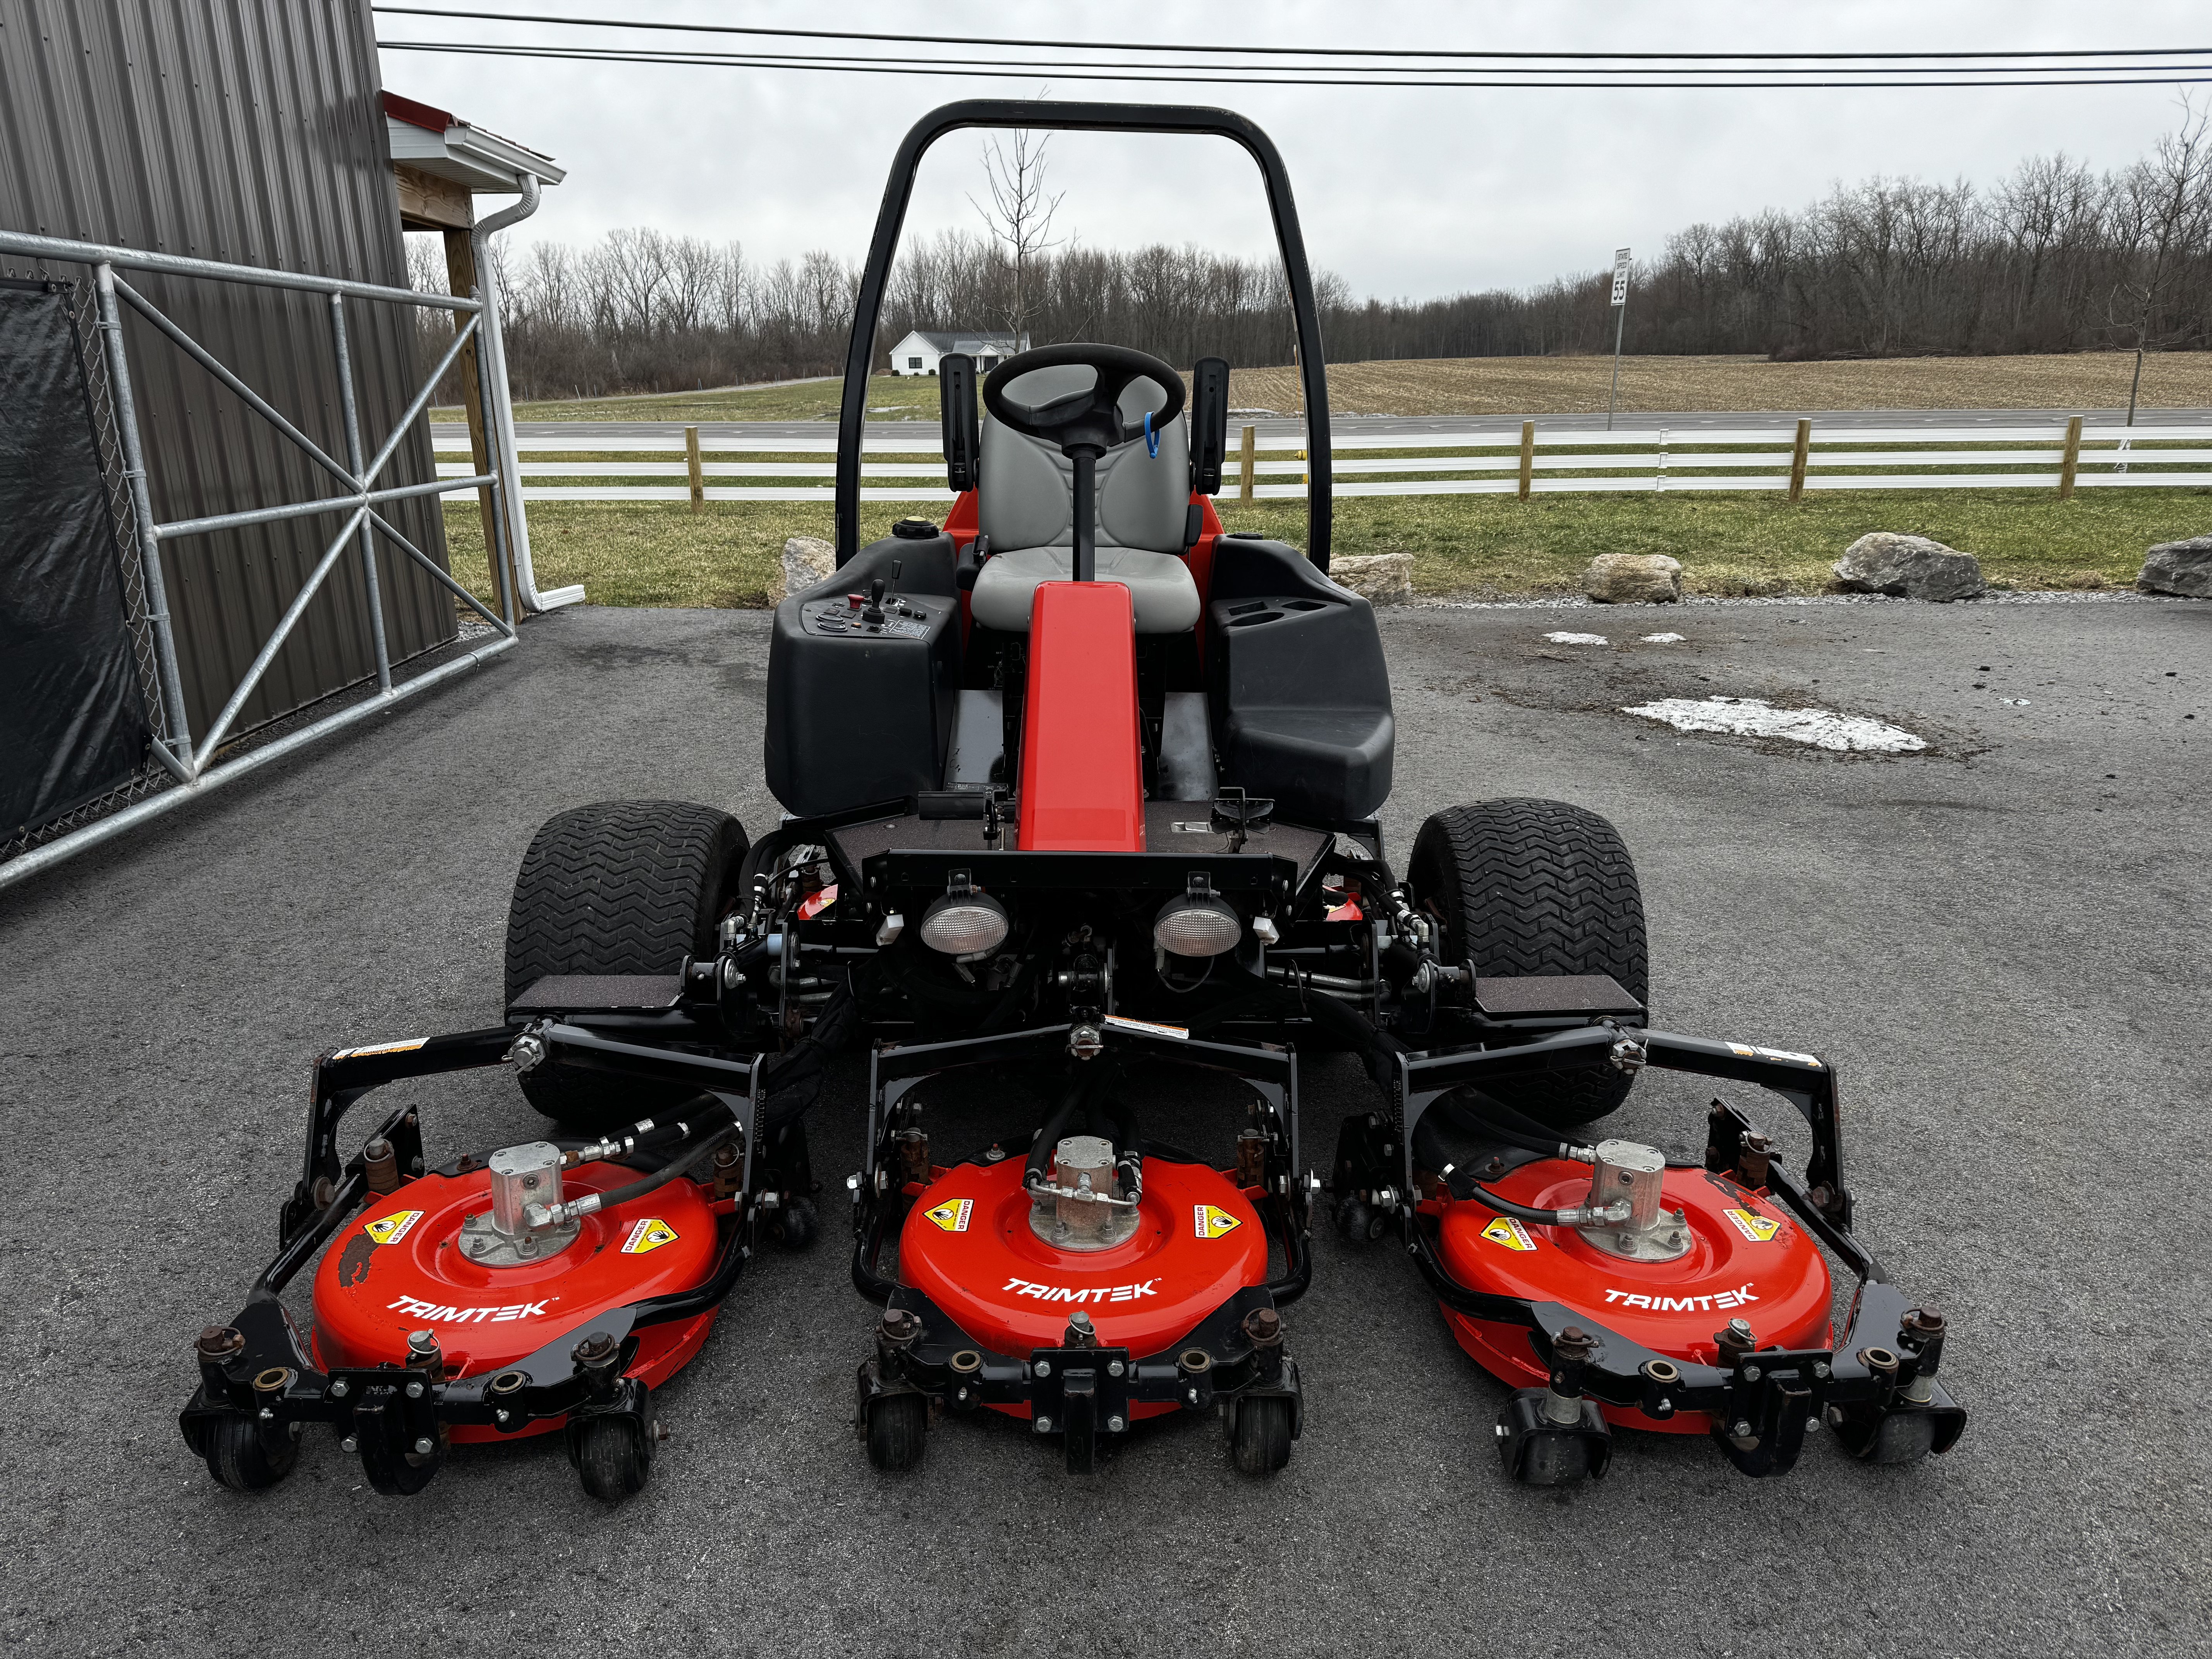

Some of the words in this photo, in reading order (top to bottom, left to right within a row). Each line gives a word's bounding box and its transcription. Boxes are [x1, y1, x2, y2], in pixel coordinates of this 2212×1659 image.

[1613, 280, 1625, 301] 55
[390, 1212, 420, 1242] DANGER
[958, 1200, 970, 1230] DANGER
[1727, 1211, 1756, 1240] DANGER
[625, 1221, 648, 1251] DANGER
[1509, 1218, 1533, 1249] DANGER
[1002, 1278, 1158, 1303] TRIMTEK
[1605, 1285, 1760, 1311] TRIMTEK
[386, 1295, 550, 1323] TRIMTEK
